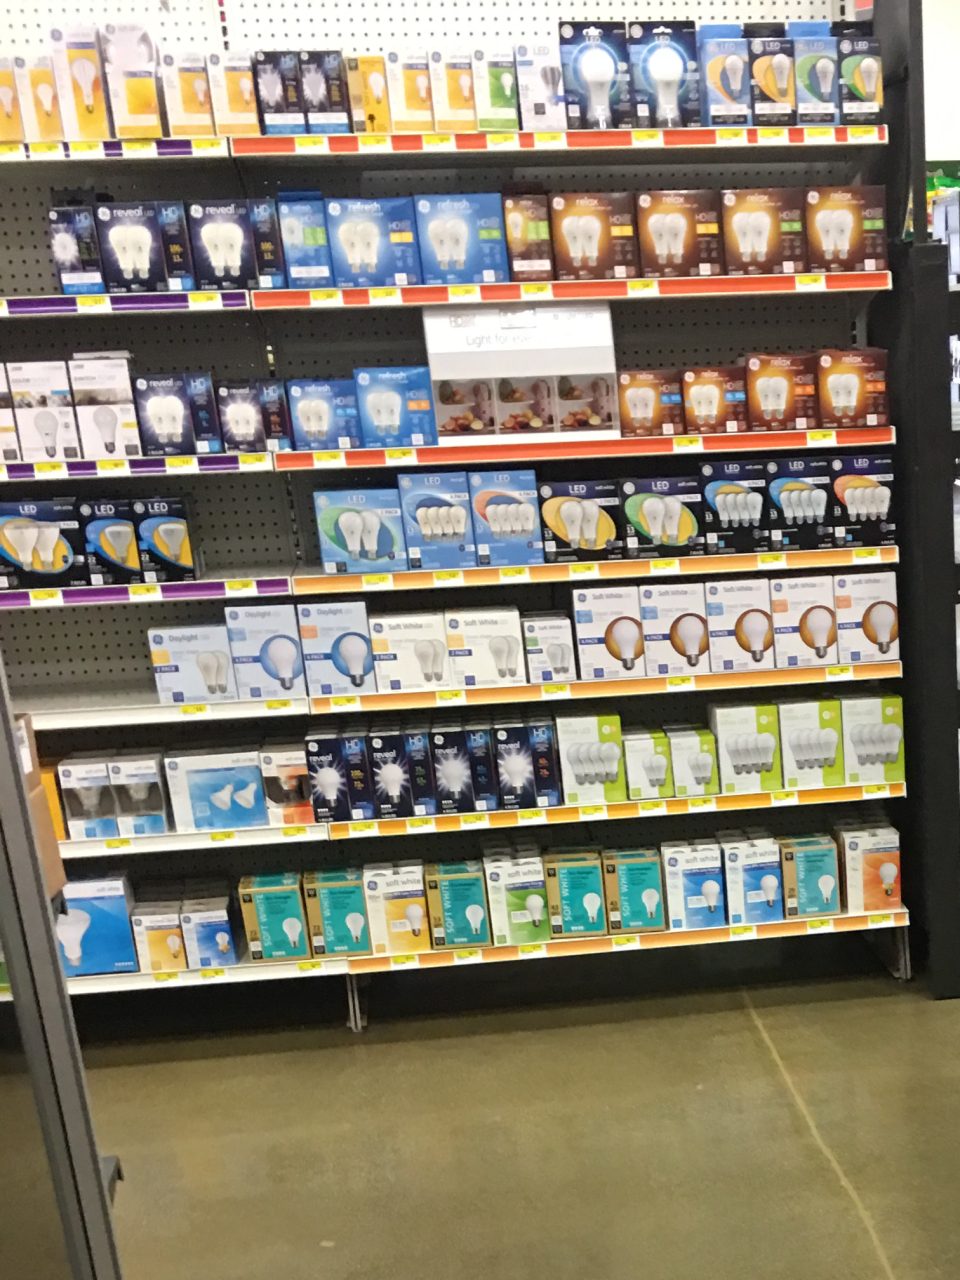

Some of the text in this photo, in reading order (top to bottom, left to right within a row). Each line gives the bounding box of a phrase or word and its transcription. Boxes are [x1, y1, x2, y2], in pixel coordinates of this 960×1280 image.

[854, 41, 868, 49] LED
[576, 197, 600, 206] relax
[662, 194, 685, 204] relax
[113, 206, 144, 217] reveal
[205, 204, 236, 215] reveal
[348, 202, 381, 212] refresh
[770, 357, 791, 366] relax
[842, 355, 862, 364] relax
[149, 378, 173, 387] reveal
[789, 461, 805, 470] LED
[854, 459, 869, 467] LED
[724, 464, 740, 473] LED
[424, 477, 441, 485] LED
[494, 474, 510, 483] LED
[569, 485, 587, 494] LED
[652, 481, 670, 490] LED
[348, 496, 365, 504] LED
[19, 505, 37, 514] LED
[95, 505, 115, 514] LED
[148, 503, 168, 512] LED
[245, 610, 271, 618] Daylight
[317, 608, 343, 616] Daylight
[169, 634, 198, 643] Daylight
[497, 742, 520, 750] reveal
[373, 751, 396, 760] reveal
[435, 747, 458, 755] reveal
[309, 754, 332, 763] reveal
[508, 868, 542, 878] soft white
[796, 852, 808, 903] SOFT WHITE
[386, 878, 421, 887] soft white
[560, 869, 572, 921] SOFT WHITE
[618, 865, 631, 916] SOFT WHITE
[442, 880, 454, 932] SOFT WHITE
[256, 894, 272, 946] SOFT WHITE
[320, 889, 334, 942] SOFT WHITE
